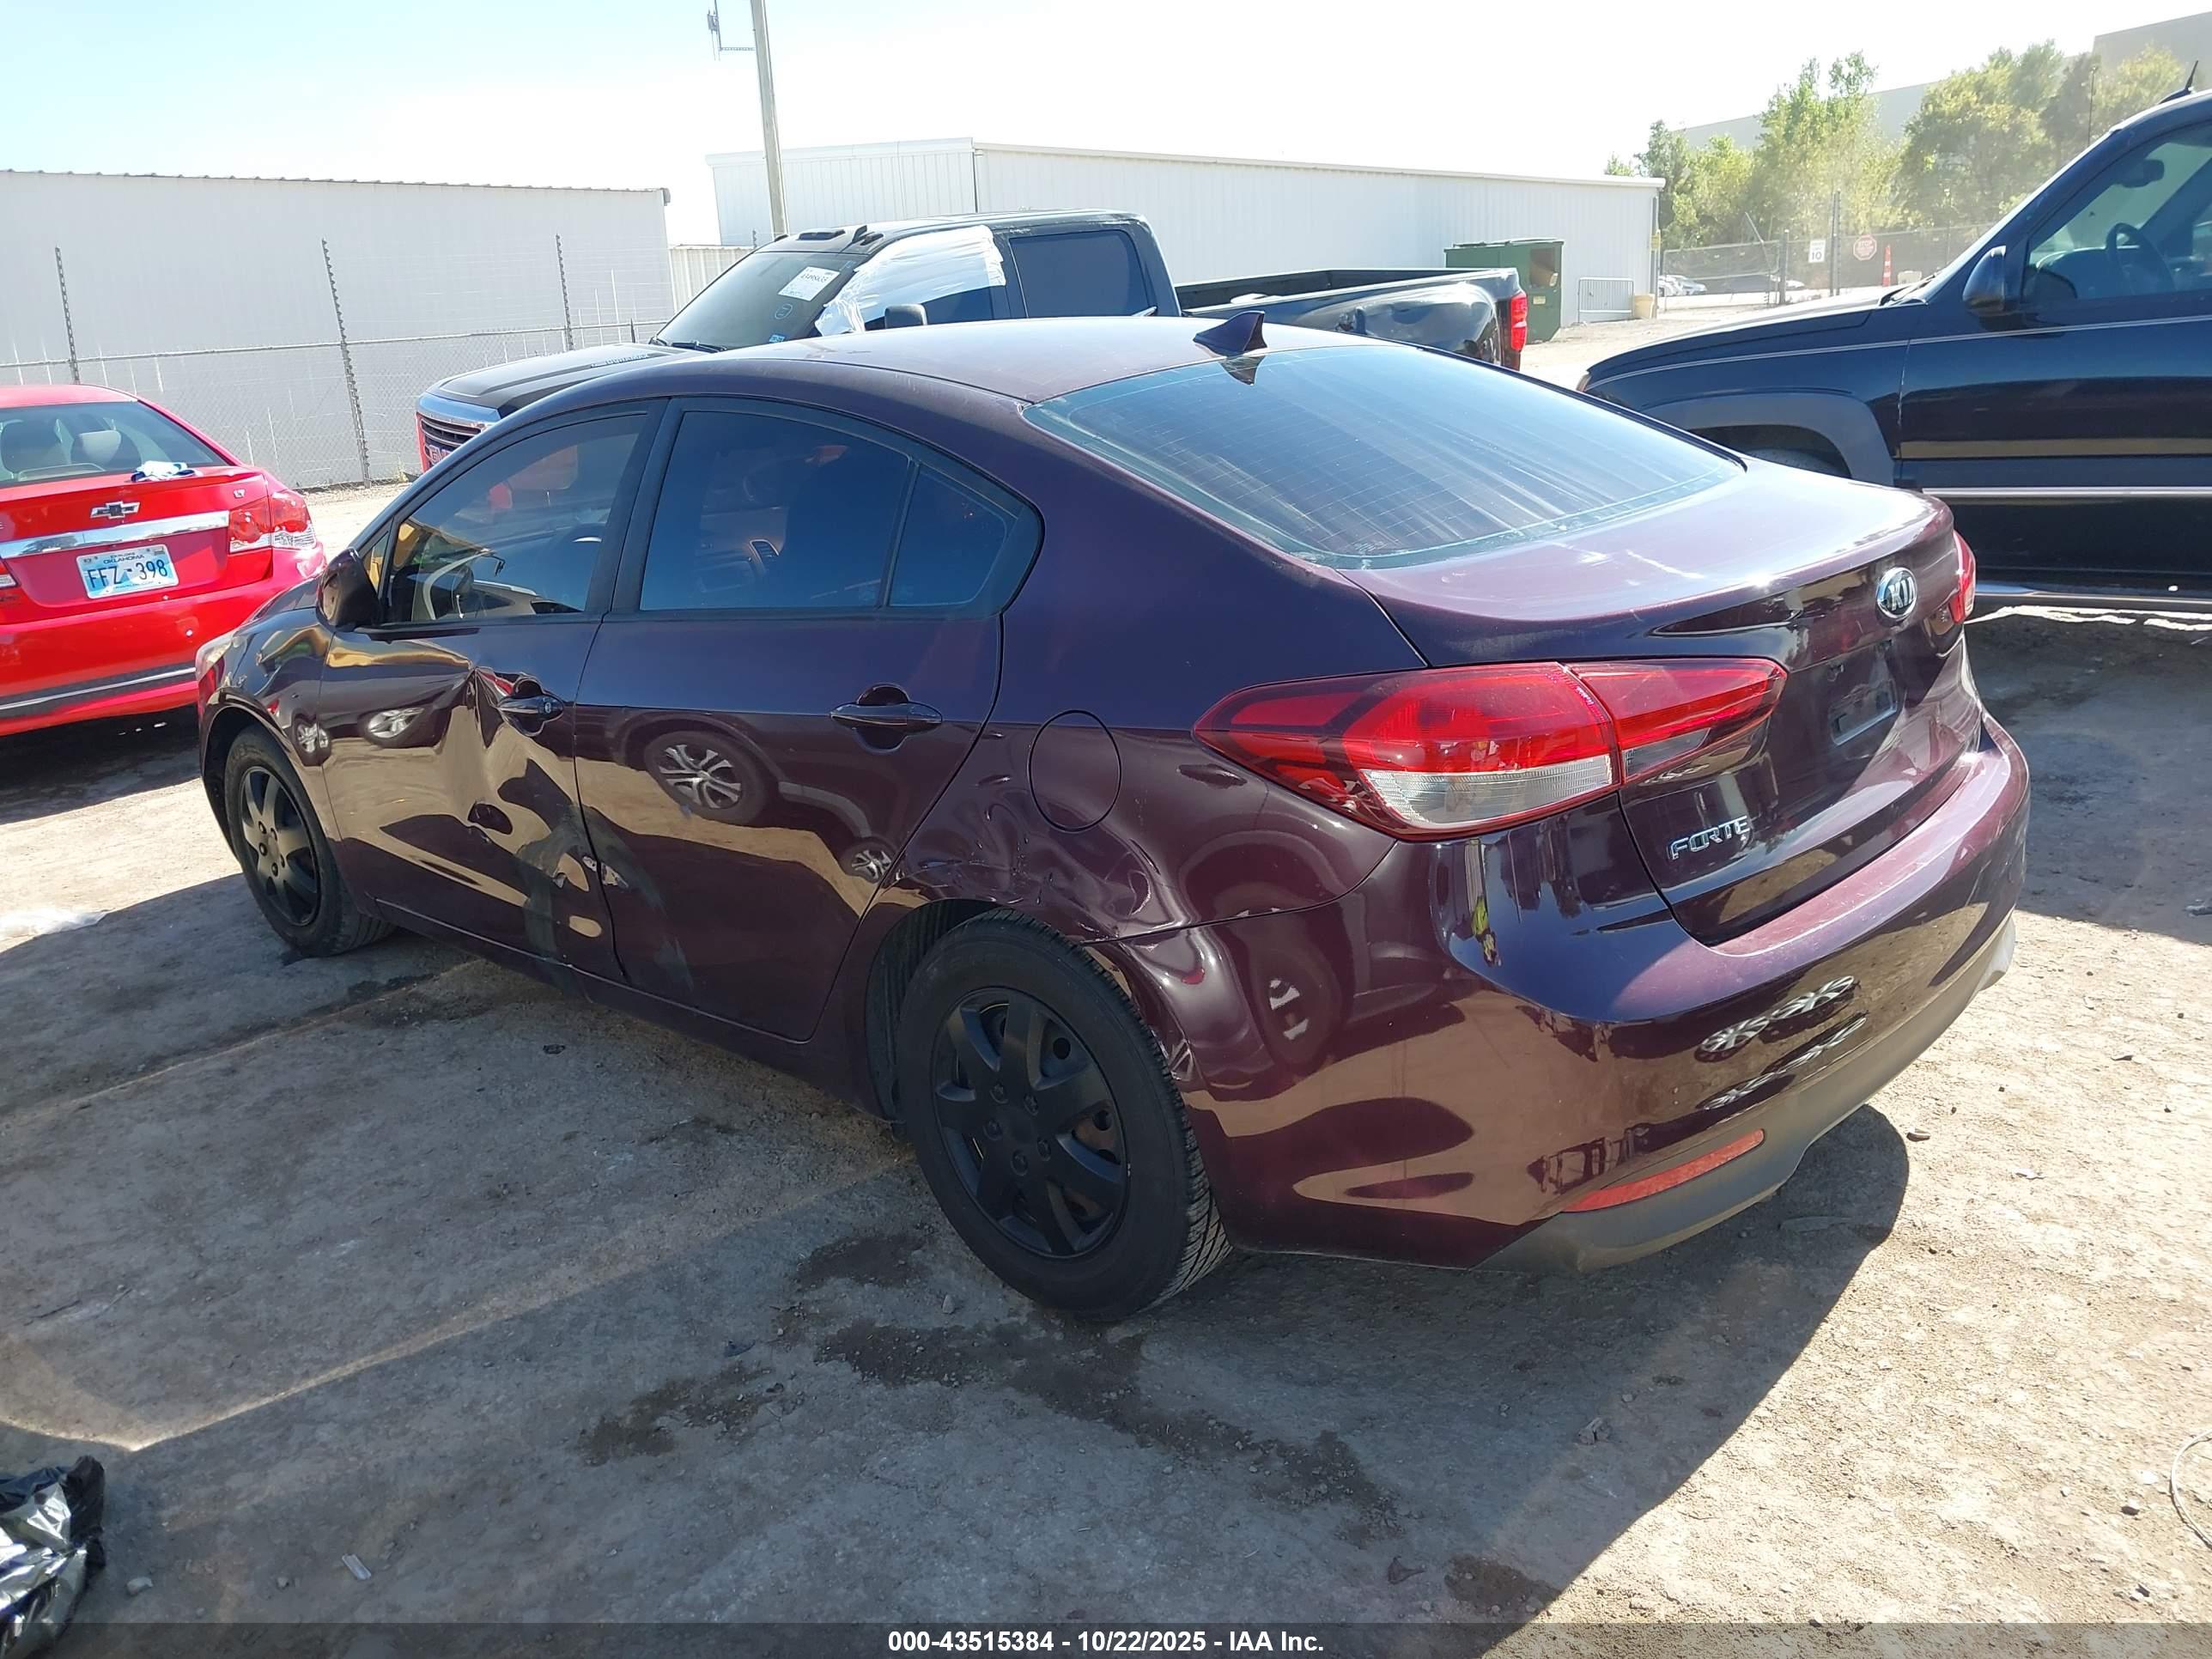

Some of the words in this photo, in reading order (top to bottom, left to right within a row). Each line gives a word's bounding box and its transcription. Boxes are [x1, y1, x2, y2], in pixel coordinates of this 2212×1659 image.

[1812, 252, 1822, 260] 10
[103, 554, 145, 564] OKLAHOMA
[1887, 576, 1914, 611] KIA
[1670, 815, 1751, 860] FORTE
